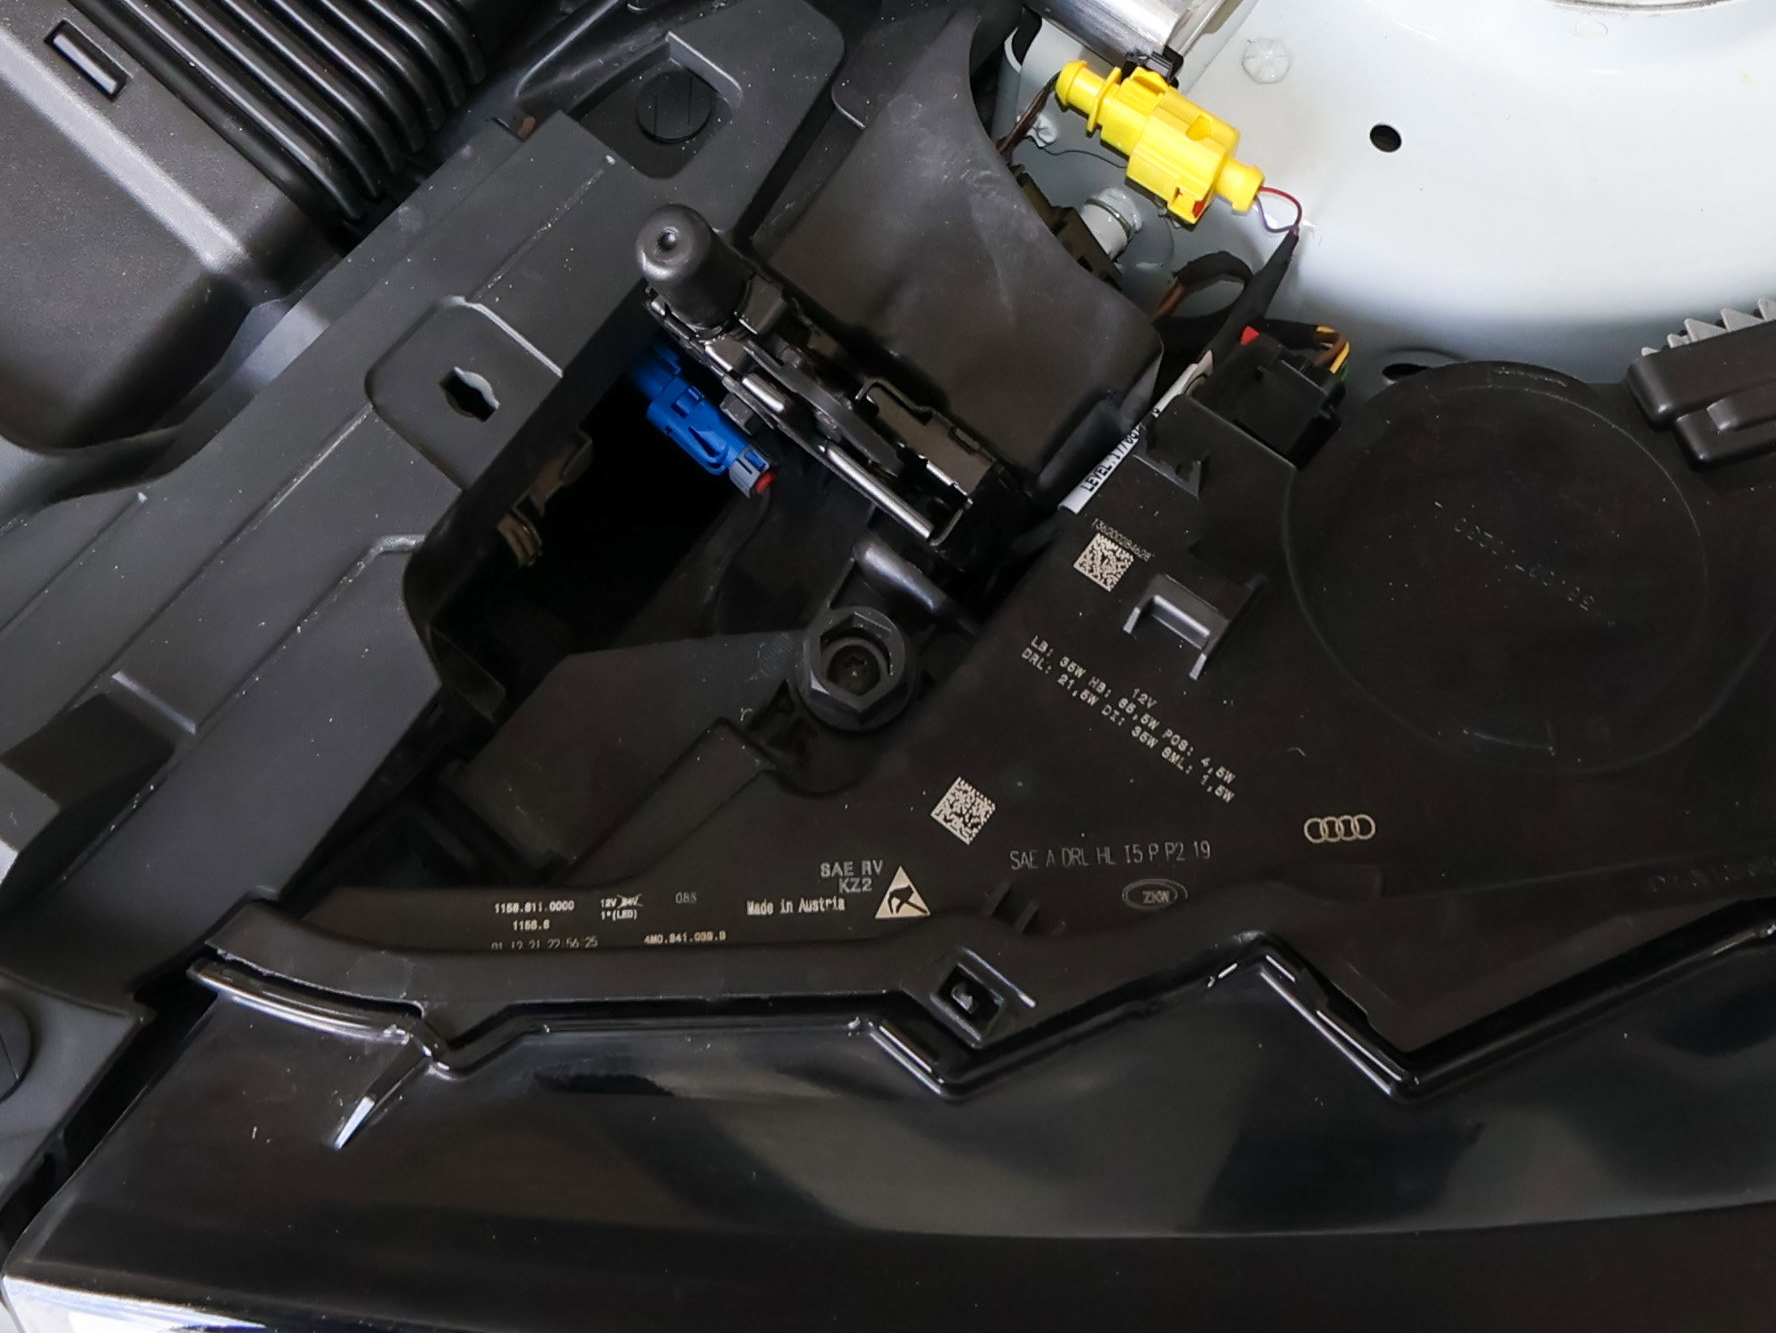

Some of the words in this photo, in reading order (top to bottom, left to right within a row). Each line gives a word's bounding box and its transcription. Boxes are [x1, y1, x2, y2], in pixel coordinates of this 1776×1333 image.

[1131, 689, 1154, 709] 12V
[1030, 636, 1054, 655] LB:
[1059, 657, 1085, 677] 35W
[1088, 677, 1112, 696] HB:
[1164, 729, 1192, 755] POS:
[1201, 756, 1233, 786] 4,5W
[1021, 647, 1053, 672] DRL:
[1057, 674, 1097, 706] 21,5W
[1102, 705, 1124, 725] DI:
[1132, 725, 1156, 748] 35W
[1162, 746, 1191, 774] SML:
[1201, 774, 1231, 805] 1,5W
[1009, 849, 1038, 870] SAE
[1045, 848, 1055, 867] A
[1061, 846, 1089, 867] DRL
[1096, 845, 1115, 865] HL
[1148, 843, 1159, 862] P
[1165, 841, 1184, 861] P2
[1193, 840, 1211, 860] 19
[820, 862, 853, 877] SAE
[861, 860, 883, 875] RV
[838, 878, 872, 893] KZ2
[746, 900, 775, 915] Made
[779, 898, 793, 913] in
[798, 895, 845, 913] Austria
[1142, 889, 1170, 904] ZKW
